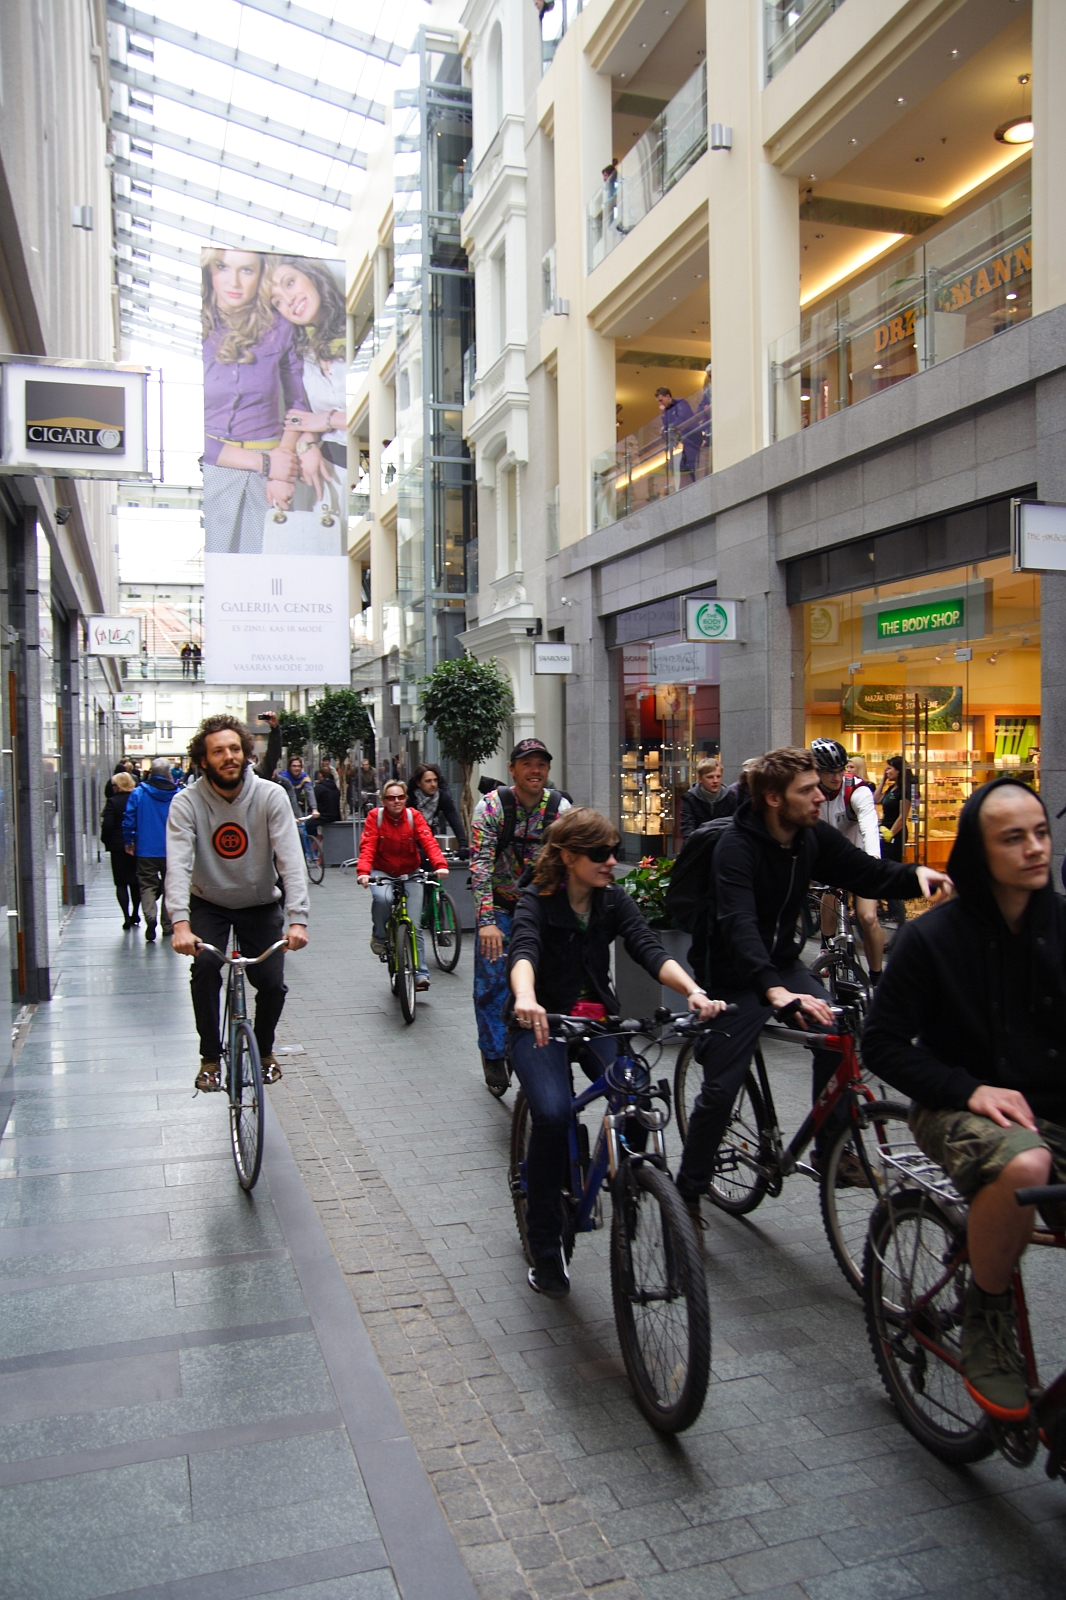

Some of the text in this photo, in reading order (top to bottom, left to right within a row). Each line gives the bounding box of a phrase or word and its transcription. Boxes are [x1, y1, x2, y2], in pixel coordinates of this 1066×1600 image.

[28, 427, 94, 444] CIGĀRI
[221, 602, 333, 614] GALERIJA CENTRS
[881, 610, 960, 635] THE BODY SHOP
